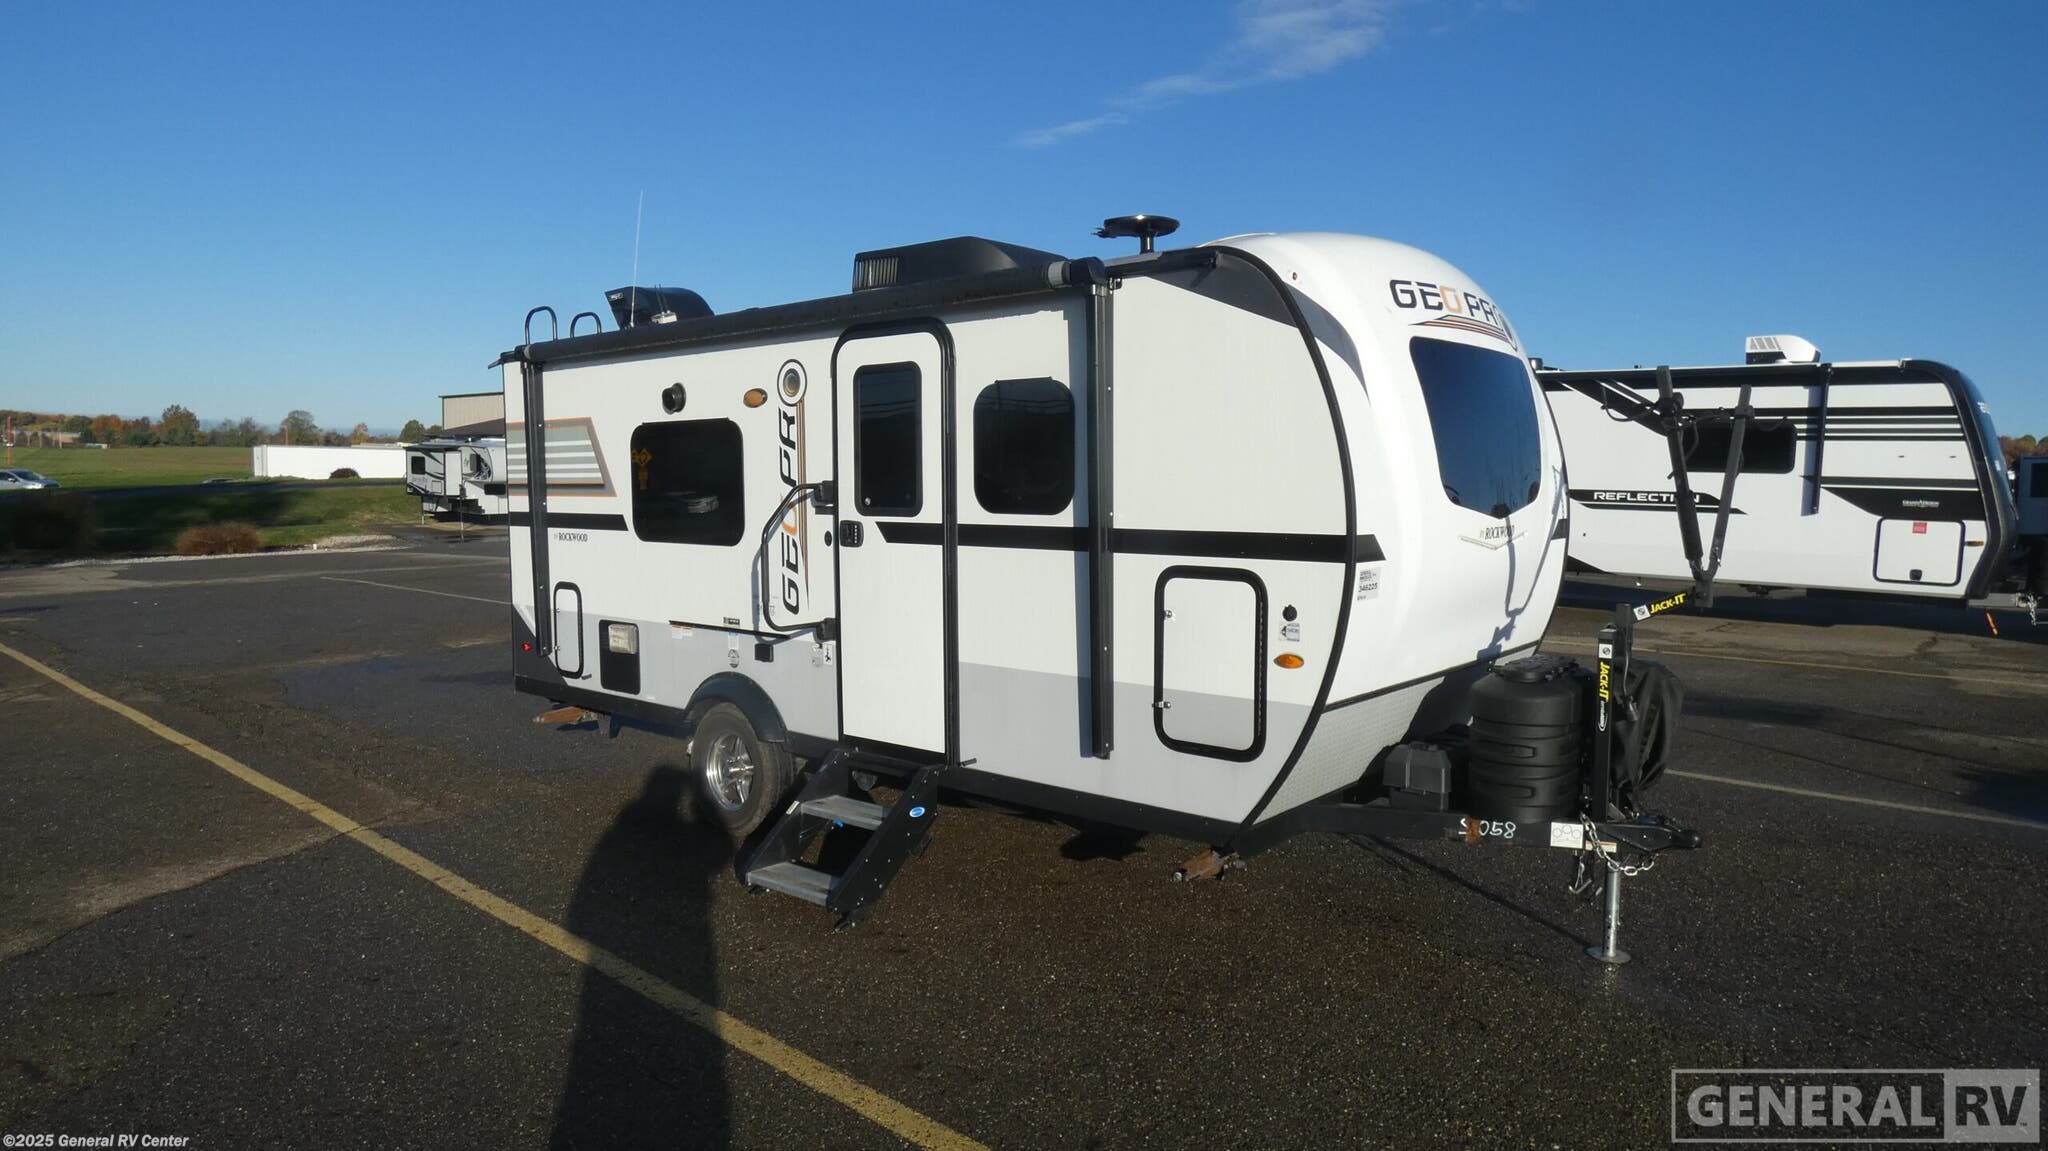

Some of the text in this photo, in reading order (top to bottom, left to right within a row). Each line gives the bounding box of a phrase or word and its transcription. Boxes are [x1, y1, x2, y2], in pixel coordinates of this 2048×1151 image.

[1390, 280, 1462, 313] GEO
[1593, 491, 1700, 503] REFLECTI
[1650, 592, 1687, 614] JACK-IT
[1599, 661, 1610, 703] JACK-IT
